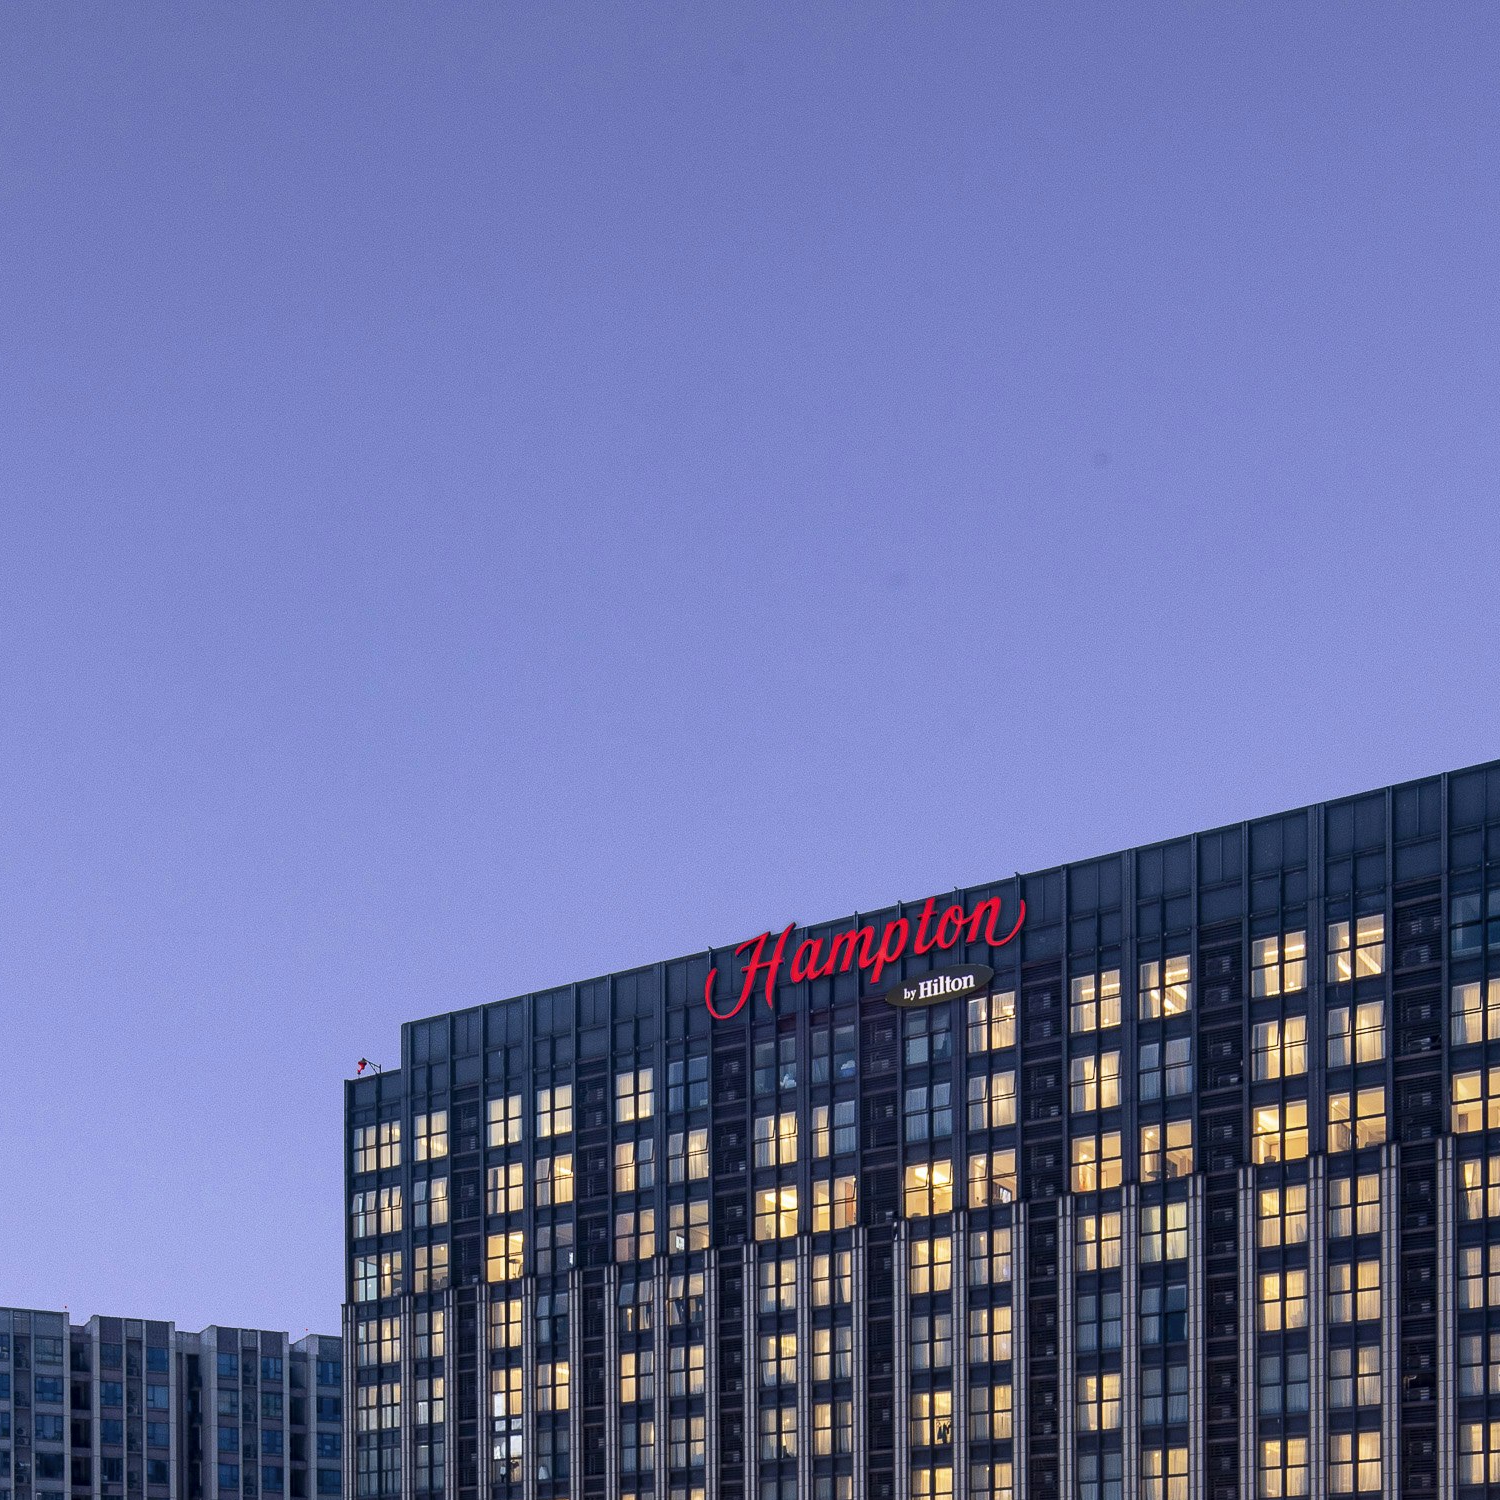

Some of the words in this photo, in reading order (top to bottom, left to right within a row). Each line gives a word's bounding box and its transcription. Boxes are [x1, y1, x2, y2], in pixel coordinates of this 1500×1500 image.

[704, 896, 1026, 1020] Hampton
[903, 987, 917, 1001] by
[918, 972, 975, 1000] Hilton
